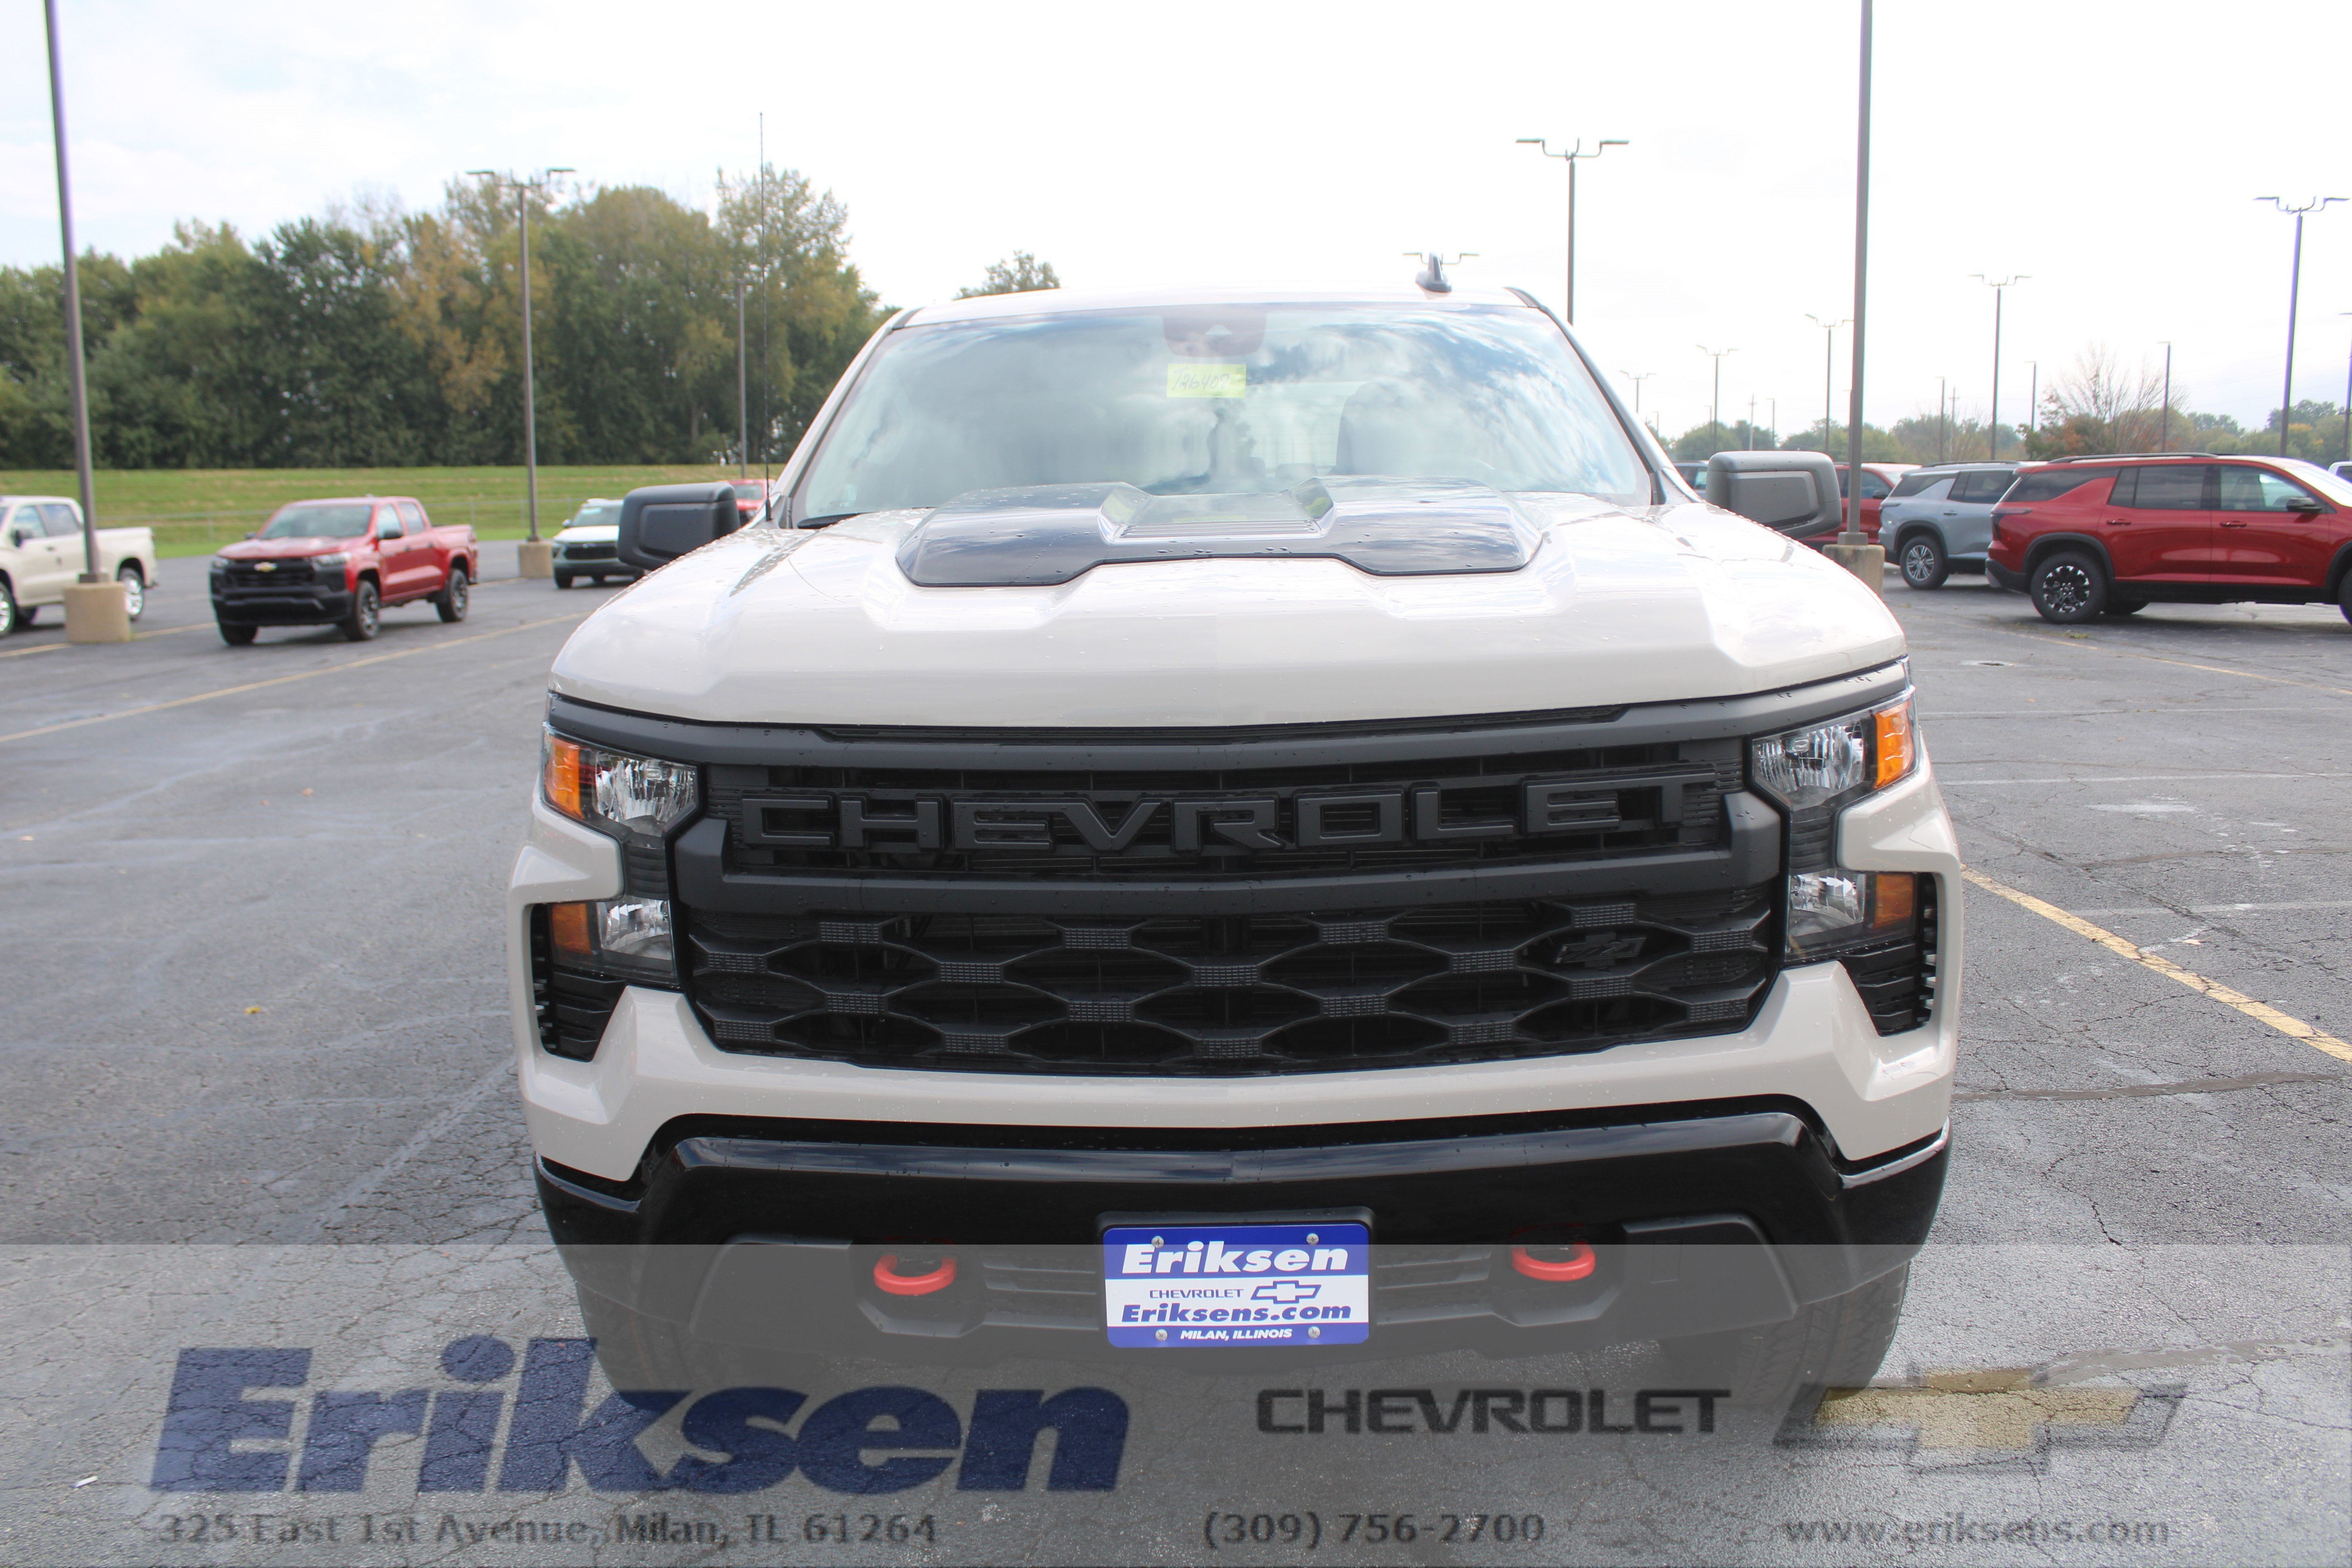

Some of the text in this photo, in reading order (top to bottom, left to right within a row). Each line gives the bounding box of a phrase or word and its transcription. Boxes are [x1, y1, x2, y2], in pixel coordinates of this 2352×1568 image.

[741, 770, 1716, 850] CHEVROLET
[1122, 1241, 1349, 1274] Eriksen
[1149, 1289, 1245, 1299] CHEVROLET
[1121, 1302, 1352, 1323] Eriksens.com
[1180, 1328, 1293, 1341] MILAN, ILLINOIS
